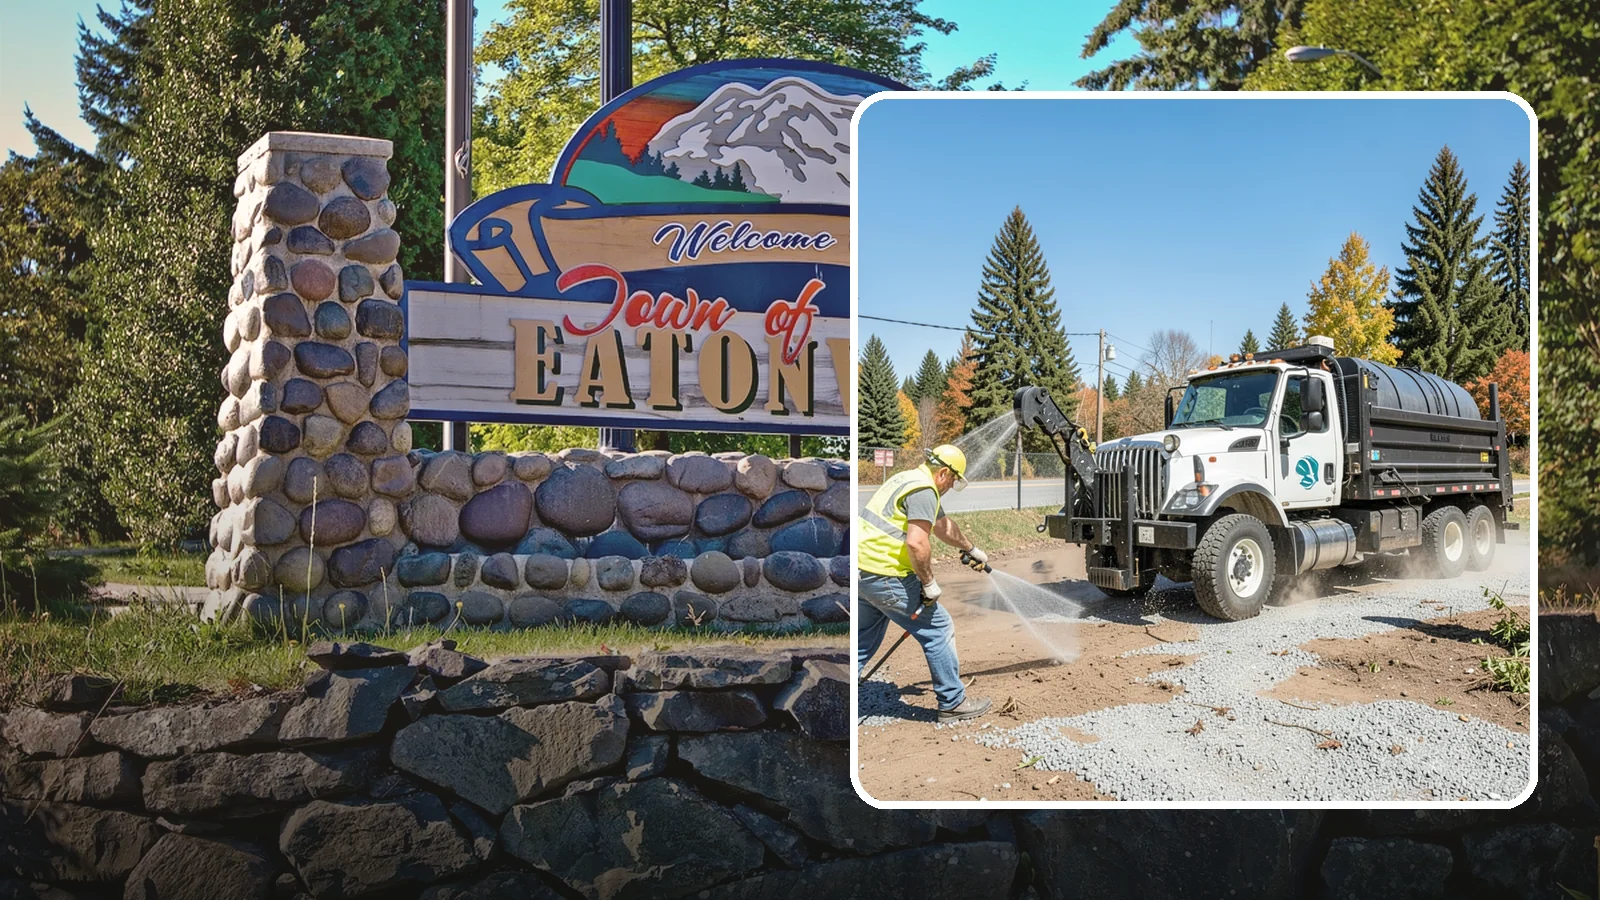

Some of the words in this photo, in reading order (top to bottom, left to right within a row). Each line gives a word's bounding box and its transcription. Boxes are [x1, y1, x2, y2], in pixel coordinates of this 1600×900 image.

[654, 221, 836, 262] Welcome
[557, 263, 736, 336] Town
[764, 278, 827, 365] of
